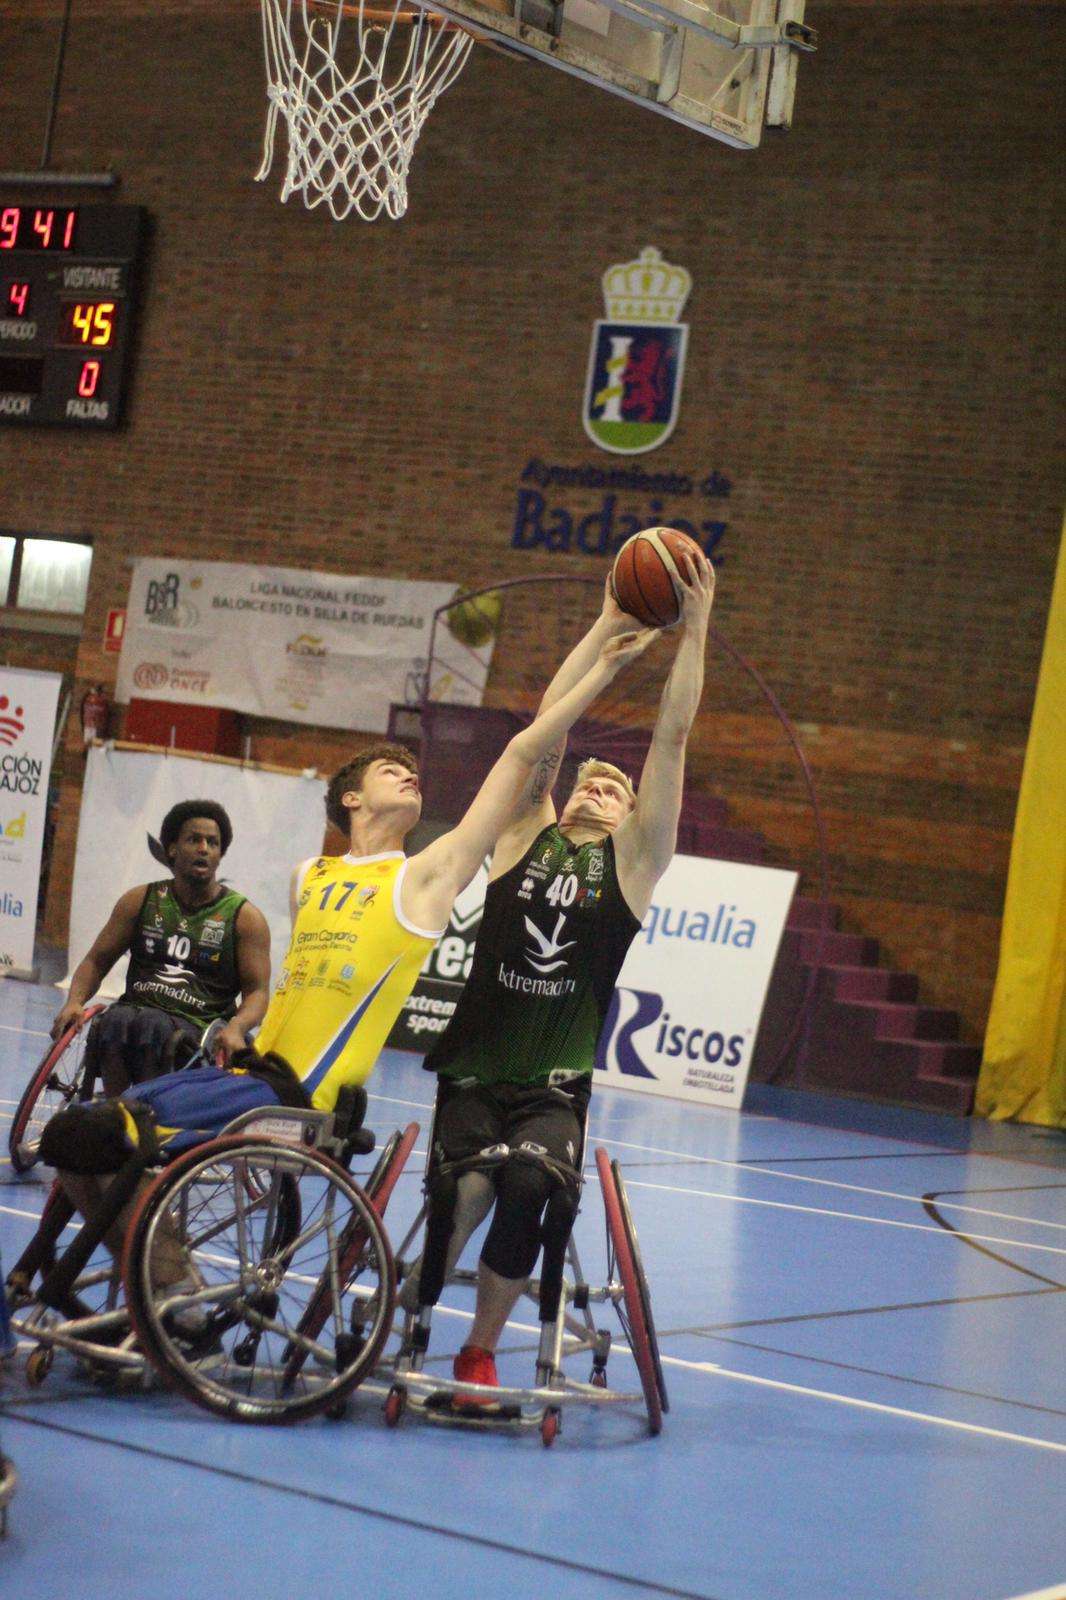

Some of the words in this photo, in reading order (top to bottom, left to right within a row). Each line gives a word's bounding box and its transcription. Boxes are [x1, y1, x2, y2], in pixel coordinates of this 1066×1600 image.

[10, 284, 29, 316] 4
[72, 303, 115, 346] 45
[77, 361, 100, 398] 0
[352, 611, 369, 624] DE
[0, 752, 43, 777] CIÓN
[319, 882, 358, 911] 17
[545, 874, 579, 907] 40
[167, 934, 191, 960] 10
